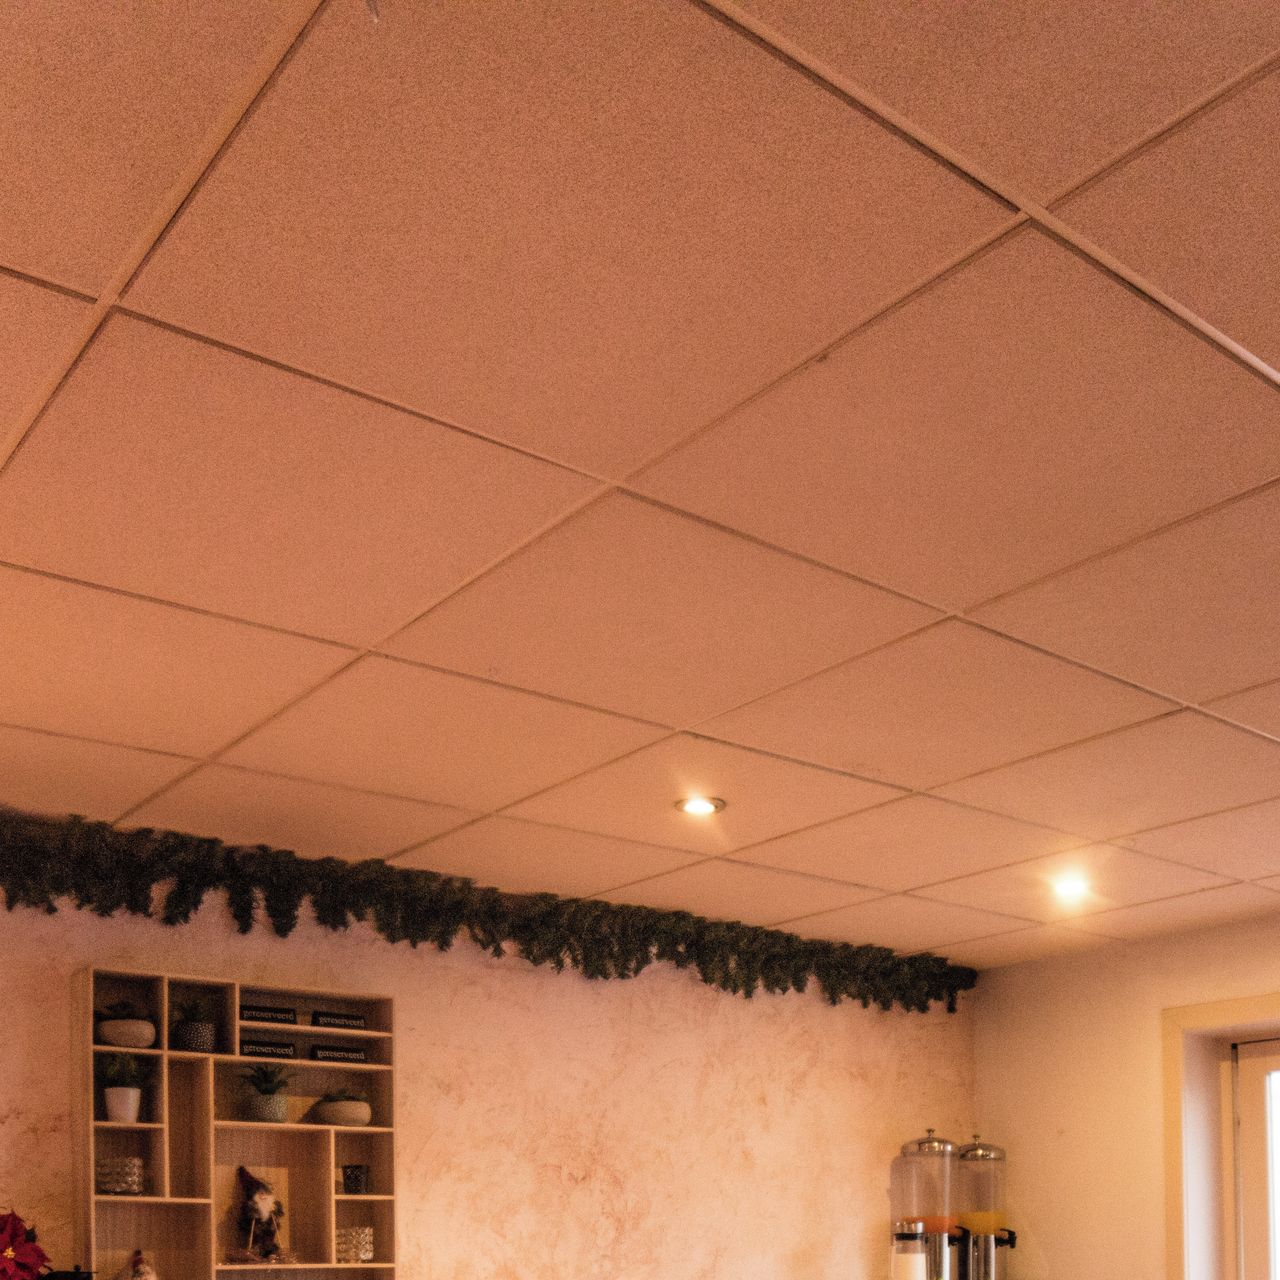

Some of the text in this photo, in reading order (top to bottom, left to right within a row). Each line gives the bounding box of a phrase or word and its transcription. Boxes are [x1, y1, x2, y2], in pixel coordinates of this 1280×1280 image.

[243, 1009, 294, 1020] gereserveerd
[319, 1016, 365, 1027] gereserveerd
[243, 1044, 294, 1056] gereserveerd
[317, 1049, 365, 1061] gereserveerd
